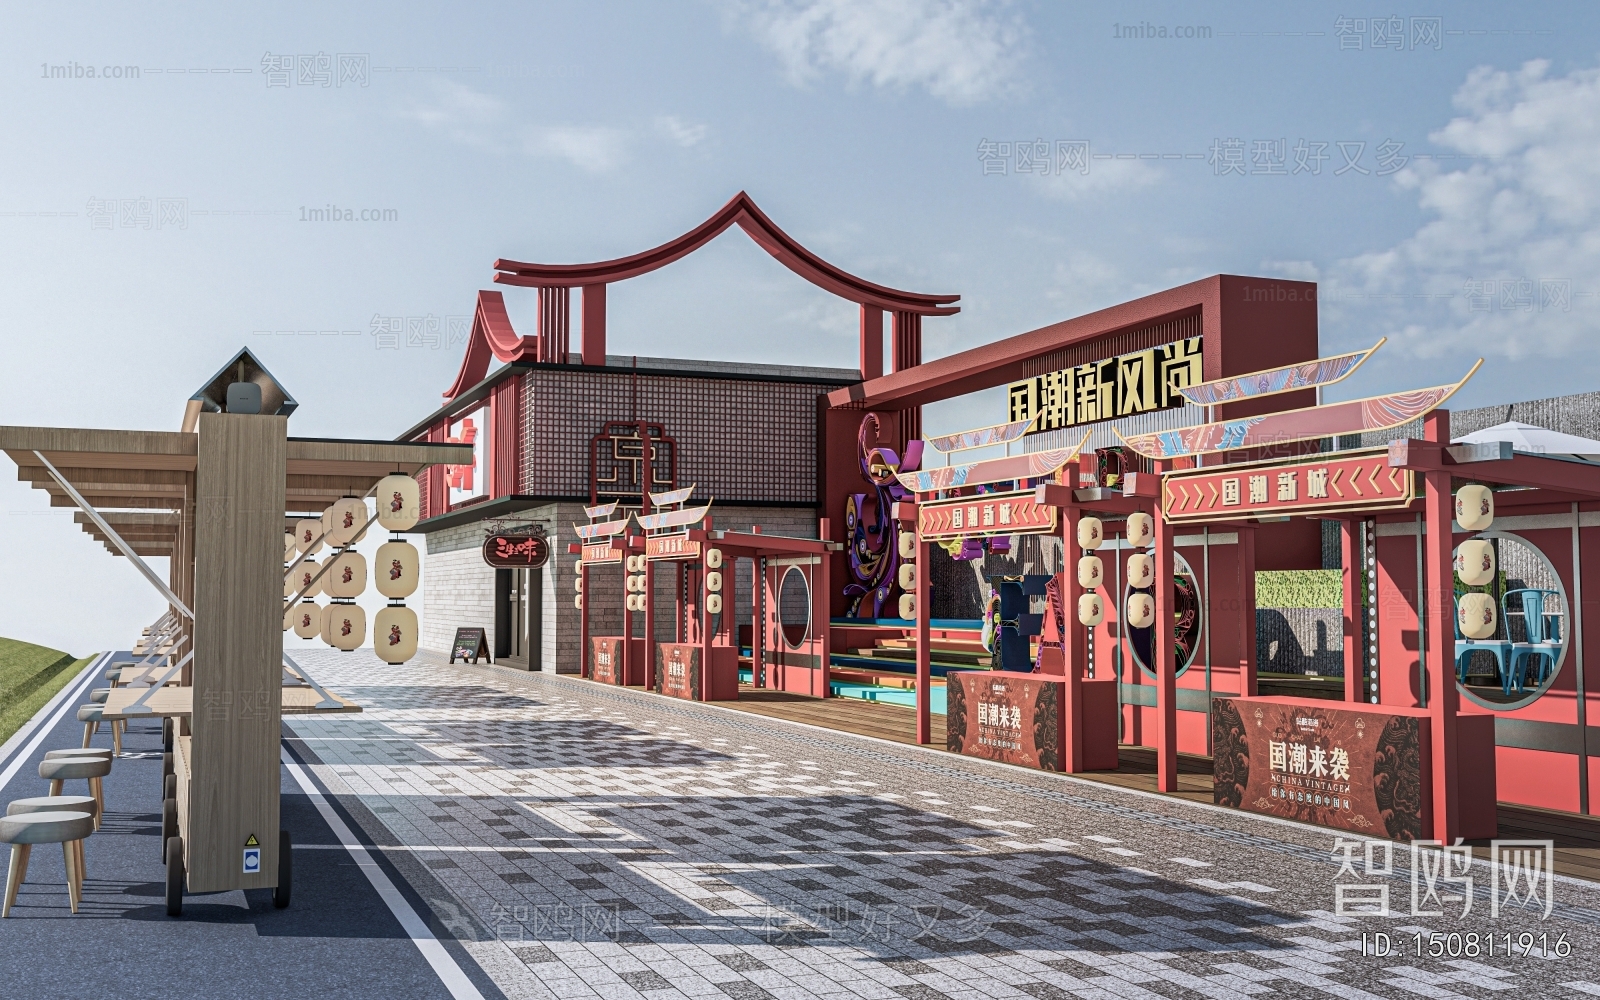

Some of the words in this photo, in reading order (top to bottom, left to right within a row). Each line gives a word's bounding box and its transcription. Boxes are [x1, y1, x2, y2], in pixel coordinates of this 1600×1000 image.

[1008, 337, 1203, 432] 国潮新风尚
[1222, 468, 1329, 506] 国潮新城
[952, 502, 1012, 529] 国潮新城
[978, 702, 1022, 730] 国潮来袭
[1269, 740, 1351, 781] 国潮来袭
[1276, 775, 1303, 787] CHINA
[1305, 779, 1346, 793] VINTAGE
